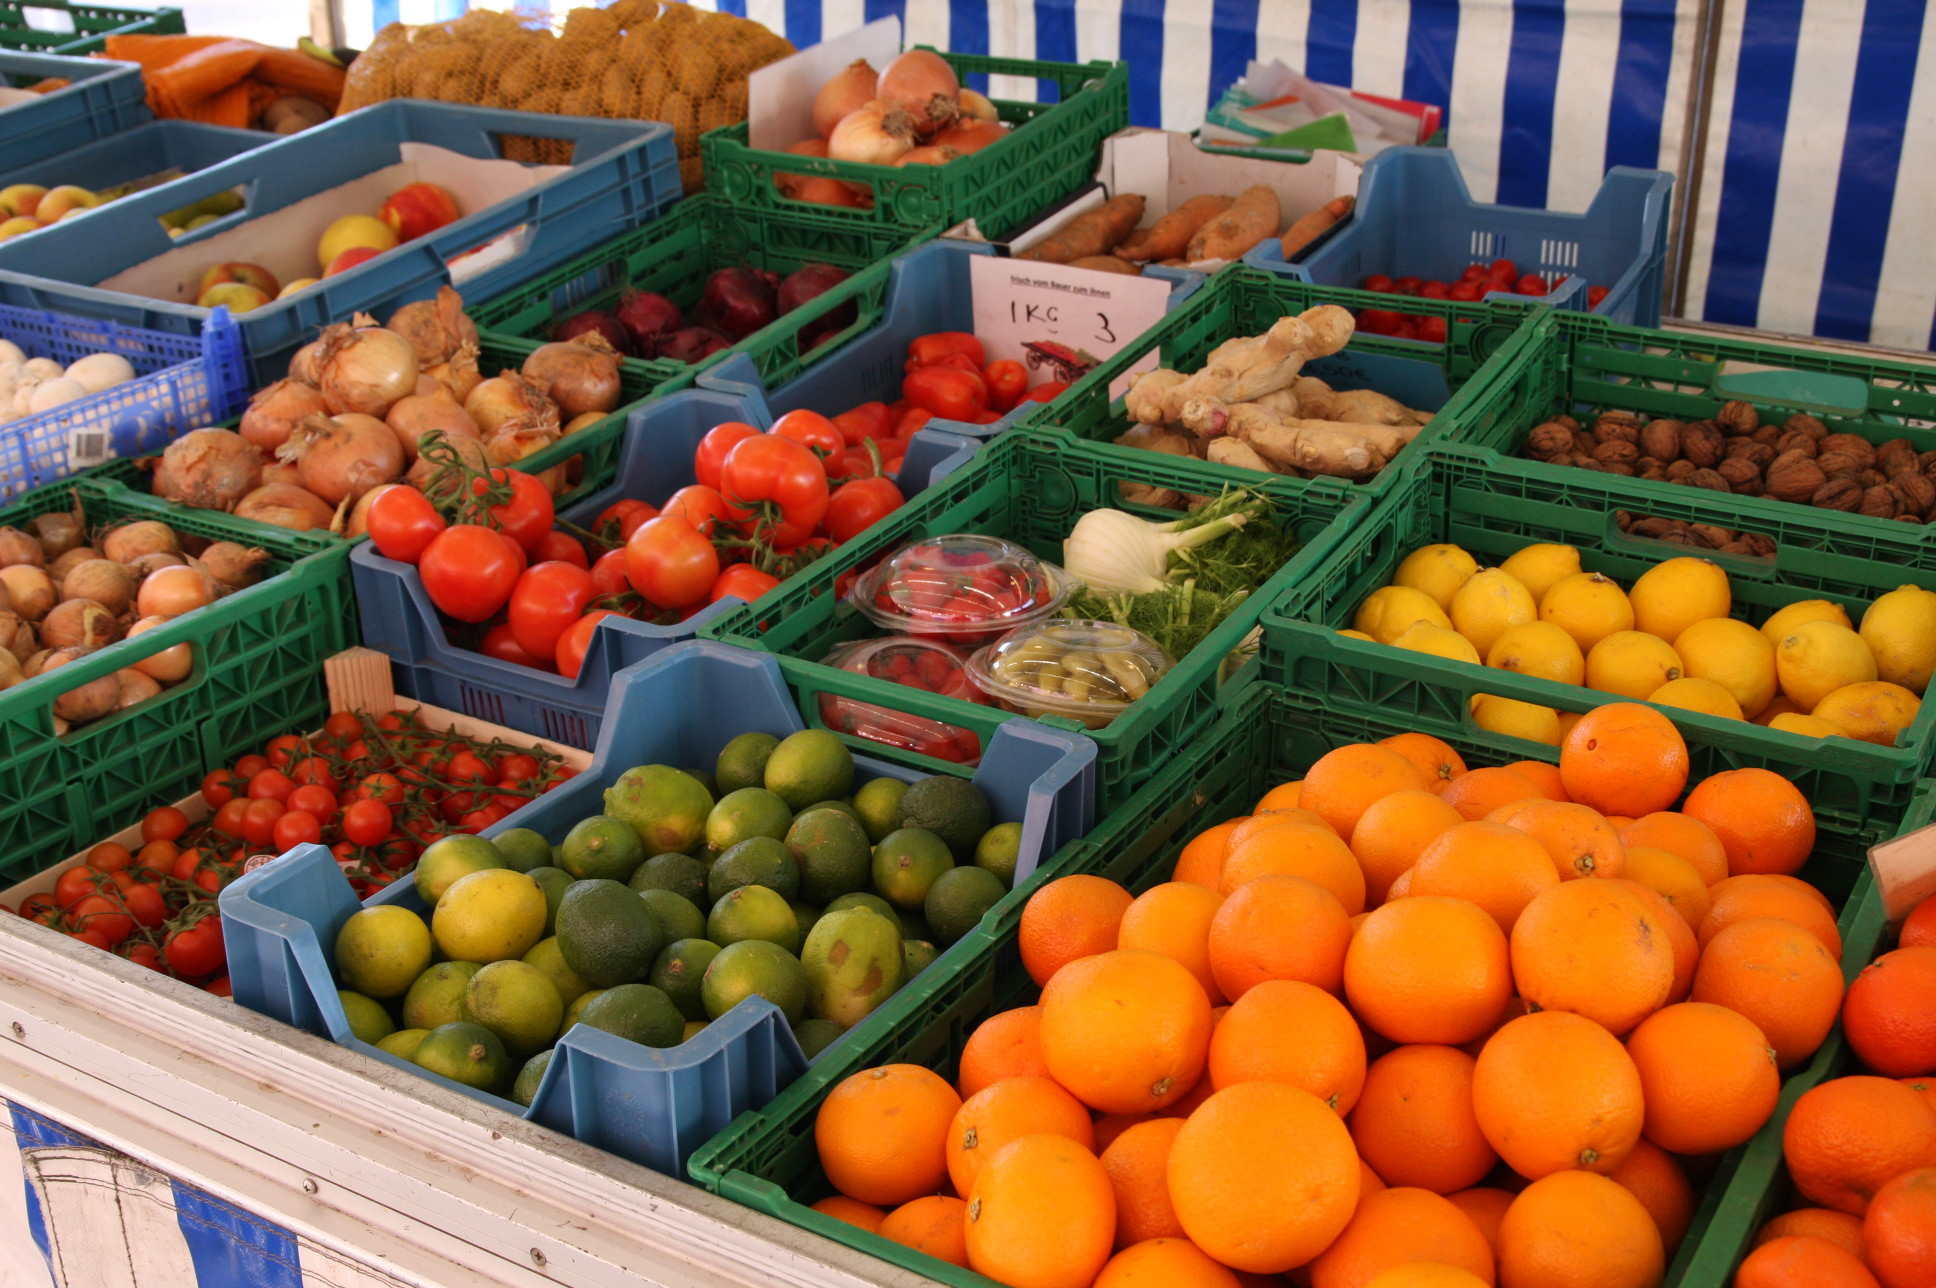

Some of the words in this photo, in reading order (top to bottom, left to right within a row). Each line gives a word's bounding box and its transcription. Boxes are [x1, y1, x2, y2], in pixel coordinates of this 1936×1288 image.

[1010, 275, 1031, 286] frisch
[1033, 279, 1049, 288] vom
[1050, 280, 1071, 291] Bauer
[1072, 286, 1088, 295] zum
[1095, 312, 1117, 344] 3
